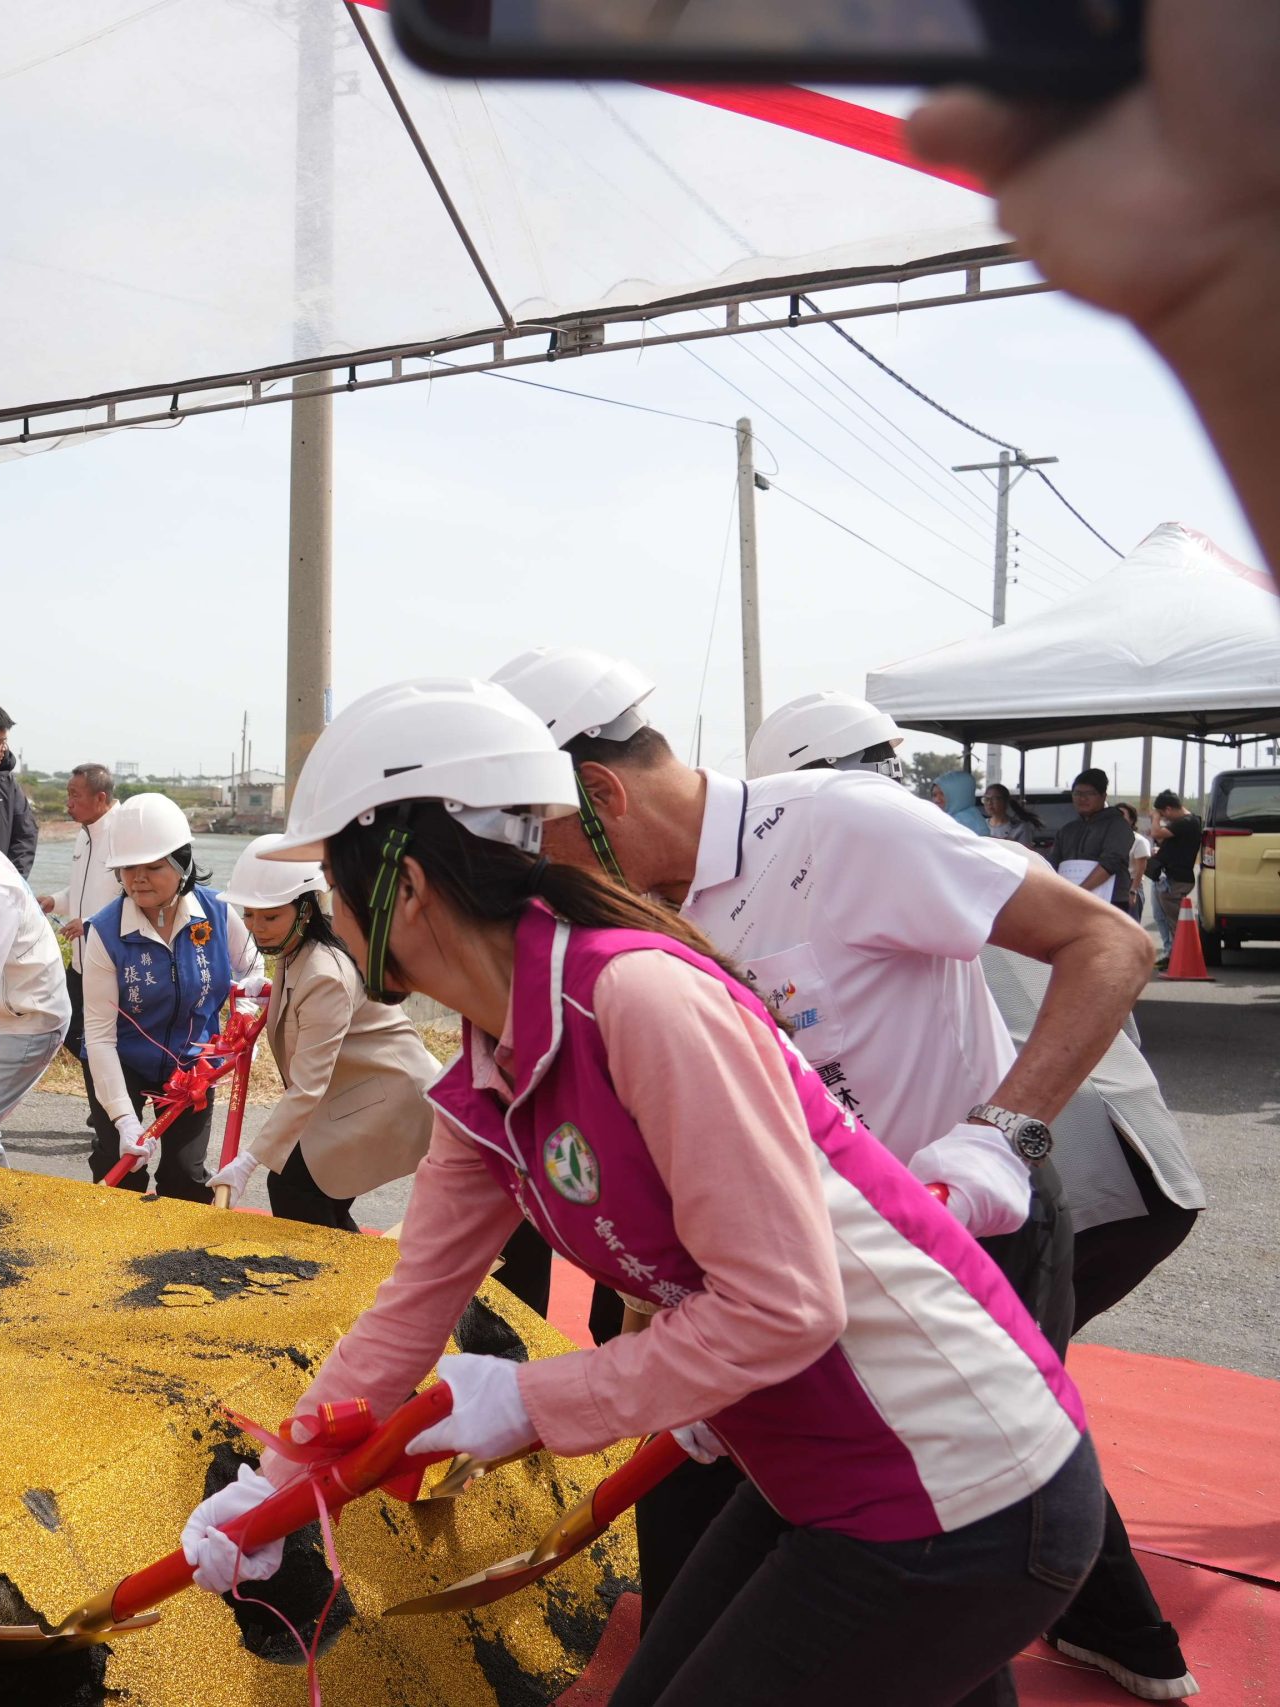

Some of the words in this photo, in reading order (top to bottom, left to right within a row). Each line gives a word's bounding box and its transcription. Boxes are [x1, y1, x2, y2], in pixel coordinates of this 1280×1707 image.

[753, 807, 785, 840] FILA
[790, 868, 808, 890] FILA
[730, 899, 747, 921] FILA
[140, 952, 157, 986] 縣長
[815, 1061, 870, 1130] 雲林
